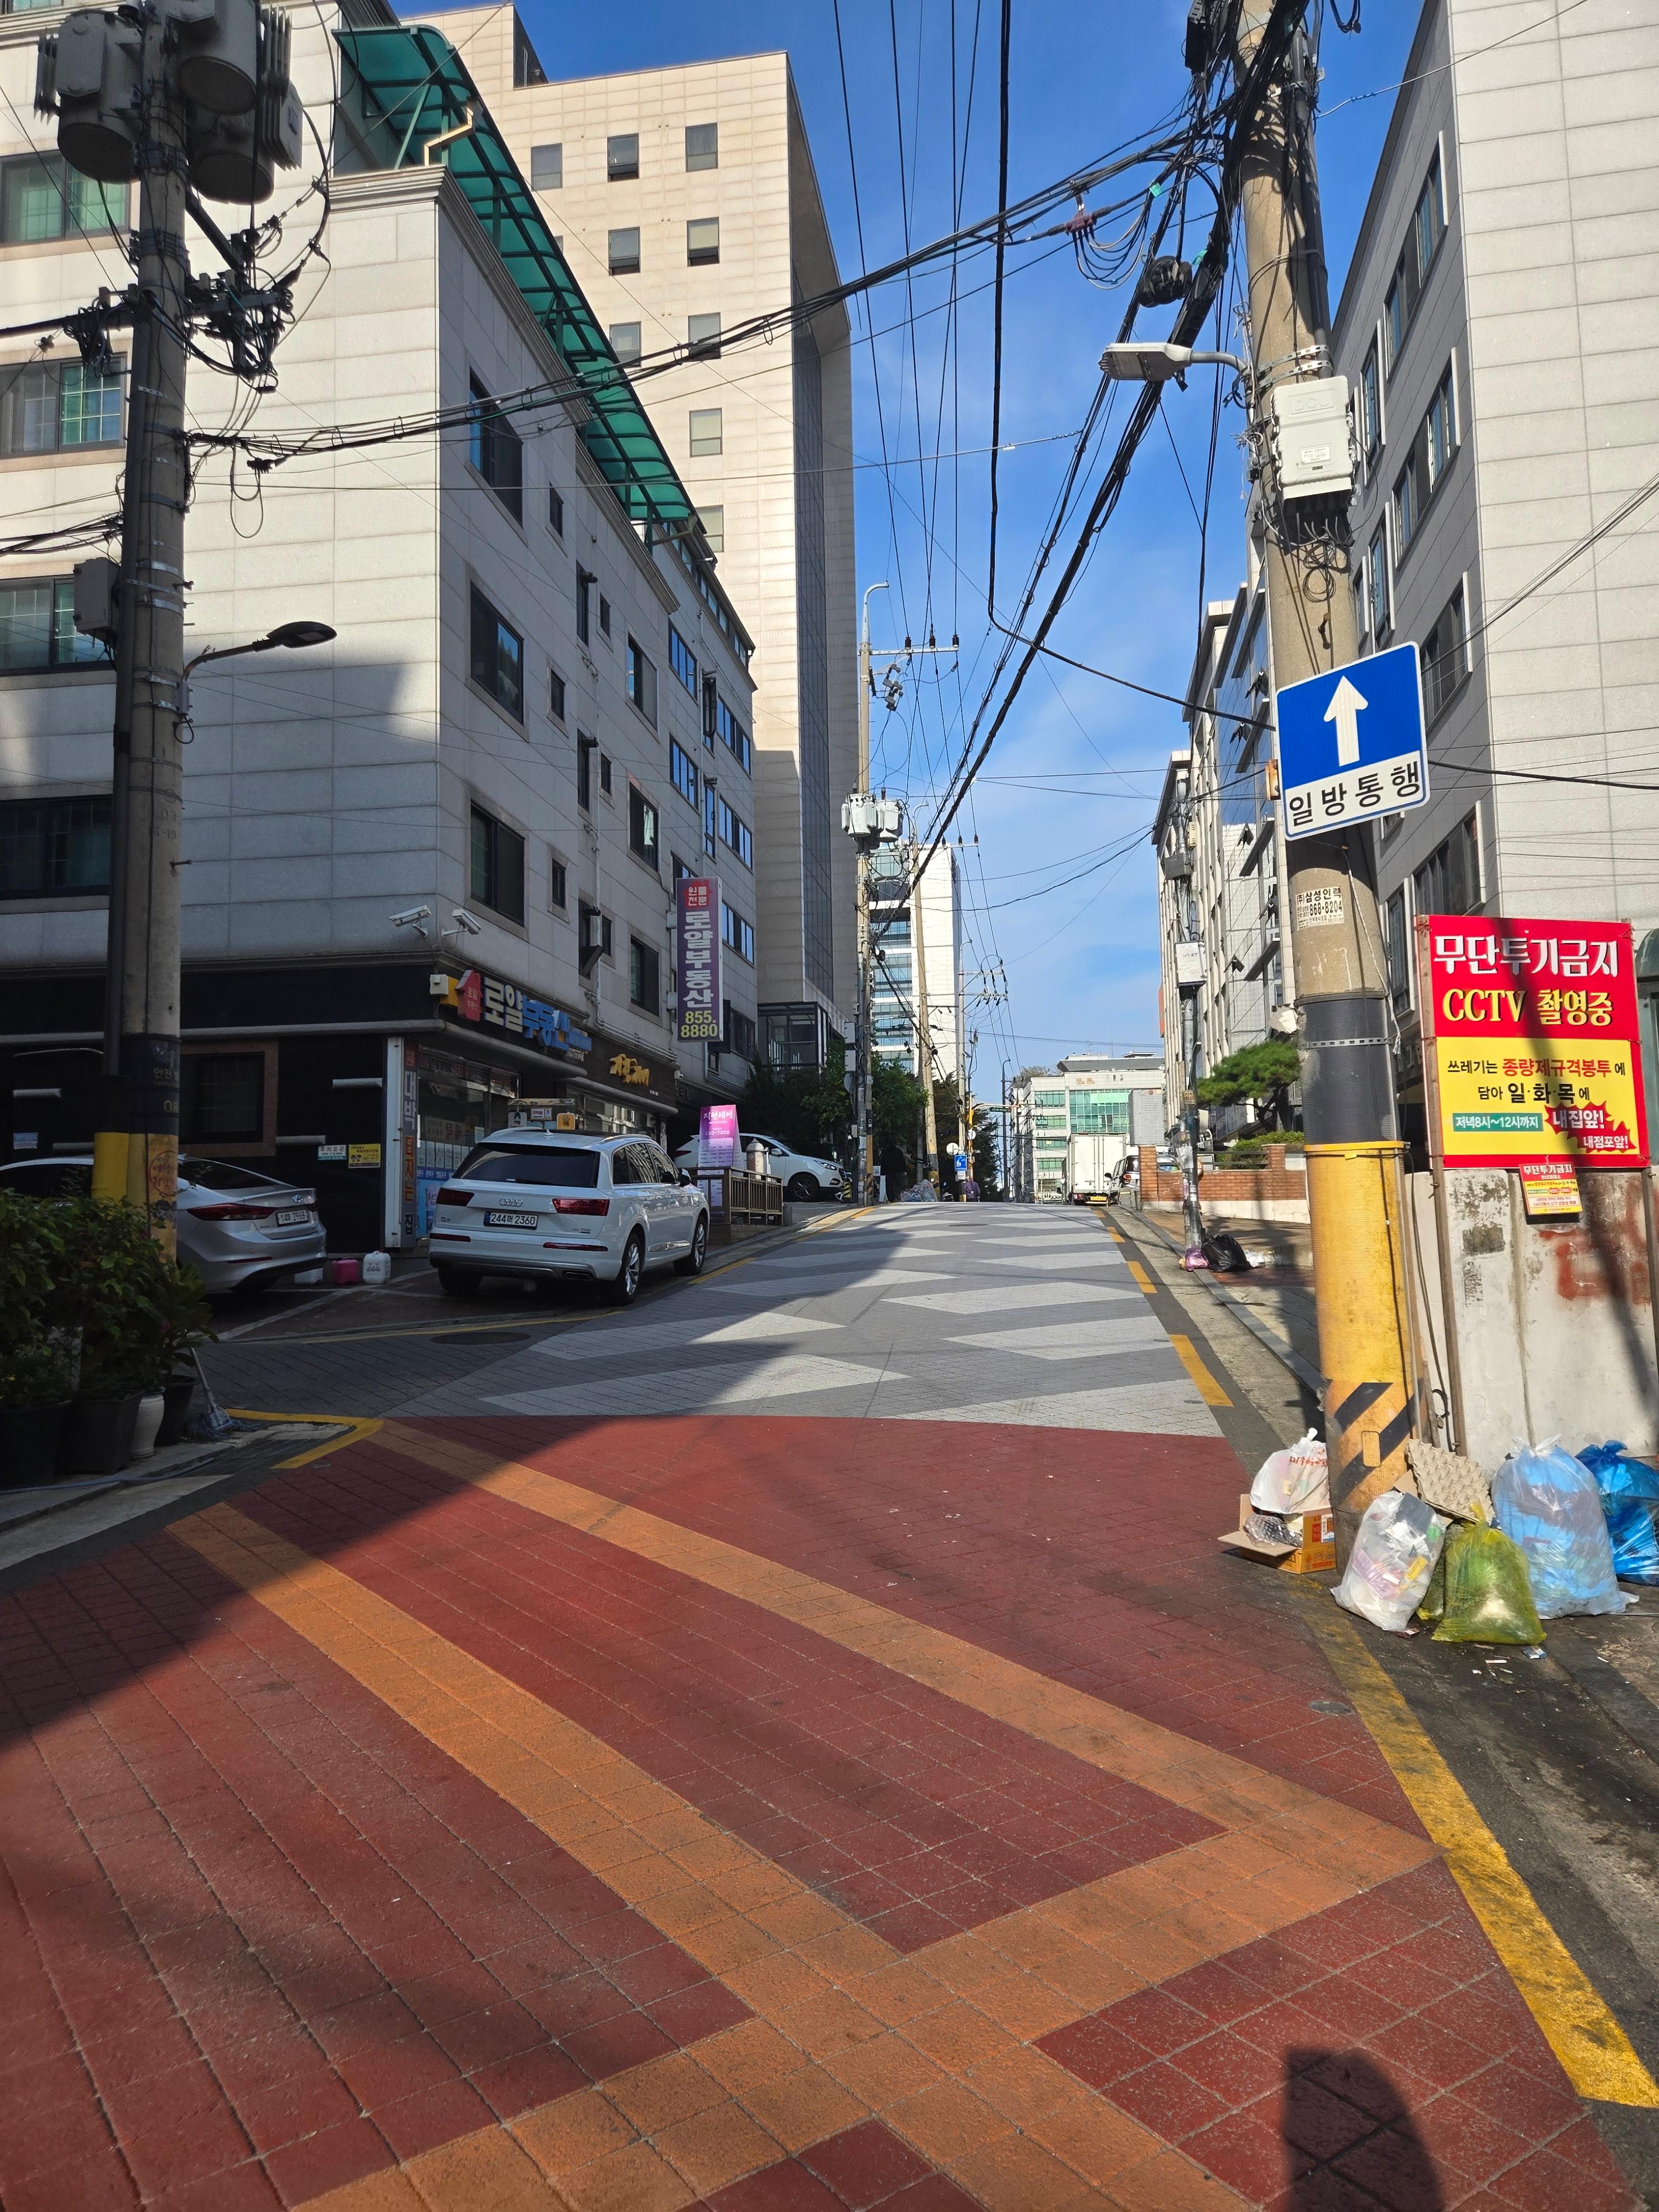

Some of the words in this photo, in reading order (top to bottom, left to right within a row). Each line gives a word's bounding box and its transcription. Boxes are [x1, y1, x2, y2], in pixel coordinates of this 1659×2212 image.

[1289, 761, 1421, 827] 일방통행
[683, 911, 714, 1008] 로얄부동산
[1433, 935, 1618, 978] 무단투기금지
[483, 977, 570, 1052] 로얄부동산
[1442, 989, 1526, 1022] CCTV
[1537, 989, 1614, 1026] 촬영중
[681, 1024, 718, 1038] 8880
[1447, 1060, 1498, 1074] 쓰레기는
[1503, 1057, 1612, 1078] 종량제규격봉투
[1478, 1086, 1503, 1101] 담아
[1579, 1087, 1590, 1100] 에
[1552, 1109, 1604, 1130] 내집앞!
[1583, 1135, 1629, 1150] 내점포앞!
[1524, 1164, 1573, 1175] 무단투기금지
[515, 1215, 536, 1225] 2360
